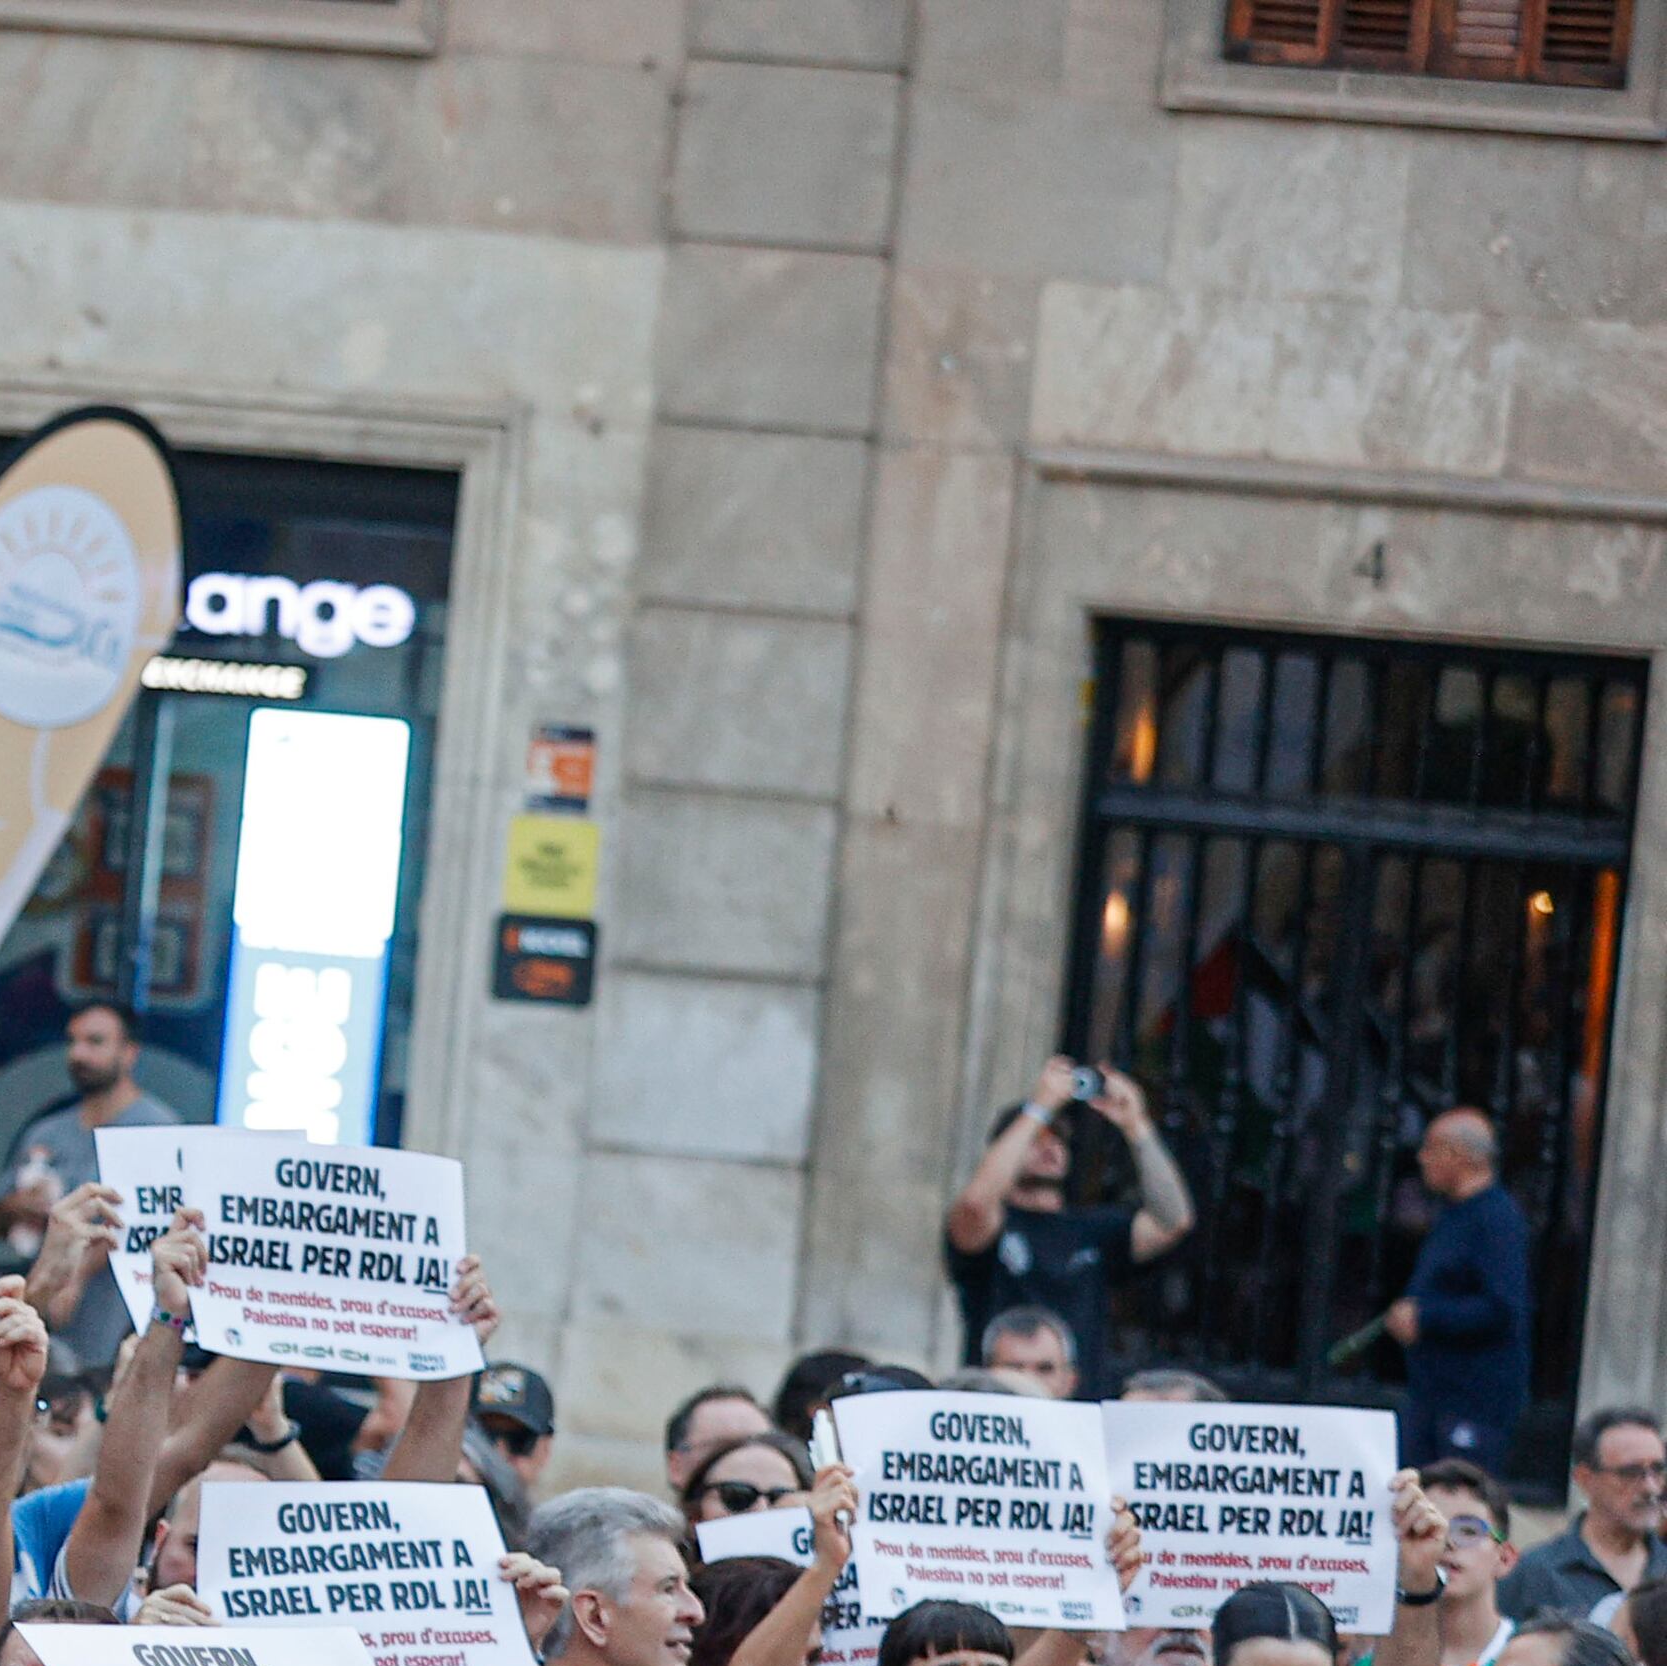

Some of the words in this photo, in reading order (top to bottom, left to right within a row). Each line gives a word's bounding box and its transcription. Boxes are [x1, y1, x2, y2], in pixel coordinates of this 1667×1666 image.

[276, 1158, 386, 1201] GOVERN,
[221, 1195, 416, 1243] EMBARGAMENT
[423, 1216, 439, 1246] A
[208, 1234, 293, 1272] ISRAEL
[301, 1244, 349, 1278] PER
[359, 1252, 406, 1284] RDL
[414, 1256, 448, 1288] JA!
[929, 1411, 1030, 1449] GOVERN,
[1189, 1423, 1305, 1460] GOVERN,
[882, 1451, 1061, 1491] EMBARGAMENT
[1067, 1461, 1084, 1491] A
[1133, 1462, 1340, 1499] EMBARGAMENT
[1347, 1470, 1365, 1499] A
[278, 1502, 401, 1534] GOVERN,
[869, 1493, 946, 1526] ISRAEL
[955, 1495, 1000, 1529] PER
[1007, 1498, 1053, 1531] RDL
[1060, 1503, 1094, 1533] JA!
[1219, 1503, 1269, 1536] PER
[1278, 1506, 1328, 1538] RDL
[1335, 1509, 1373, 1539] JA!
[229, 1541, 443, 1578] EMBARGAMENT
[453, 1539, 472, 1568] A
[222, 1586, 321, 1618] ISRAEL
[326, 1584, 382, 1613] PER
[390, 1580, 446, 1610] RDL
[455, 1579, 490, 1609] JA!
